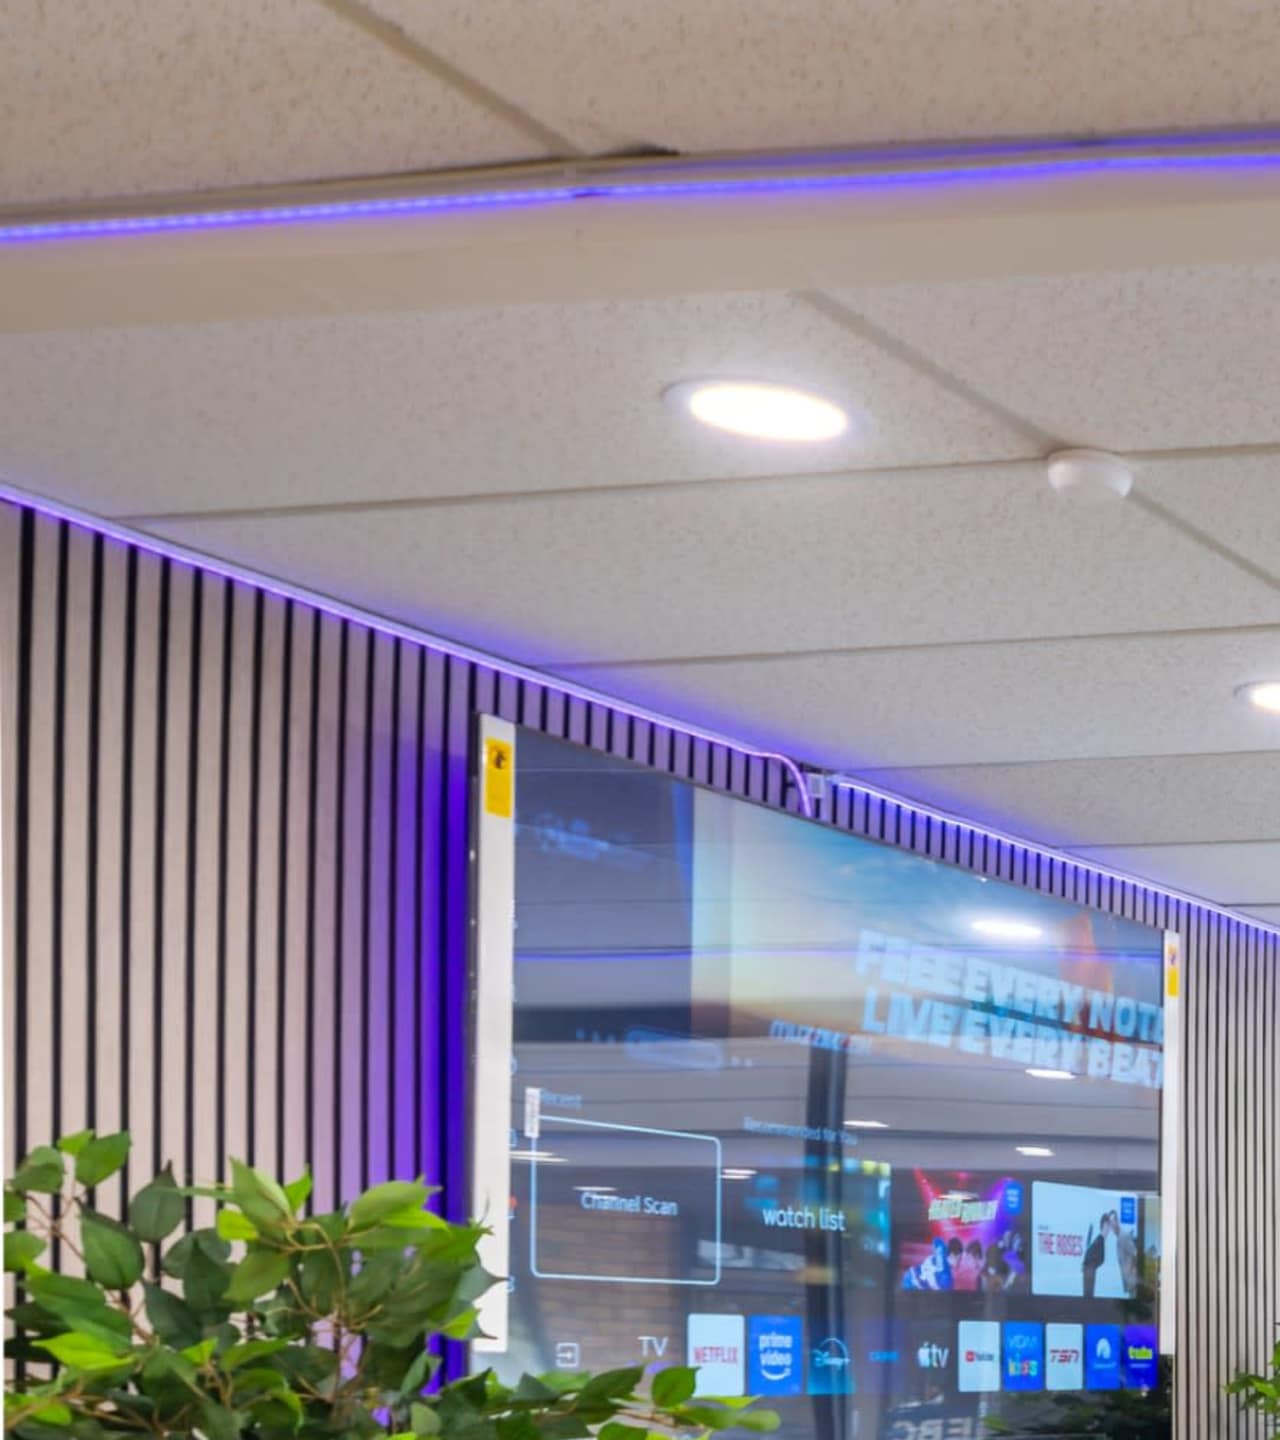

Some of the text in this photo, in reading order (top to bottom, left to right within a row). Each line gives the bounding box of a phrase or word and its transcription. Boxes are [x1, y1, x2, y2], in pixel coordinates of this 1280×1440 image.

[963, 956, 1083, 1027] EVERY
[957, 1008, 1083, 1072] EVERY
[581, 1191, 678, 1216] Channel Scan
[762, 1206, 845, 1232] watch list
[637, 1336, 668, 1357] TV
[759, 1332, 793, 1349] prime
[693, 1346, 738, 1364] NETFLIX
[760, 1350, 792, 1366] video
